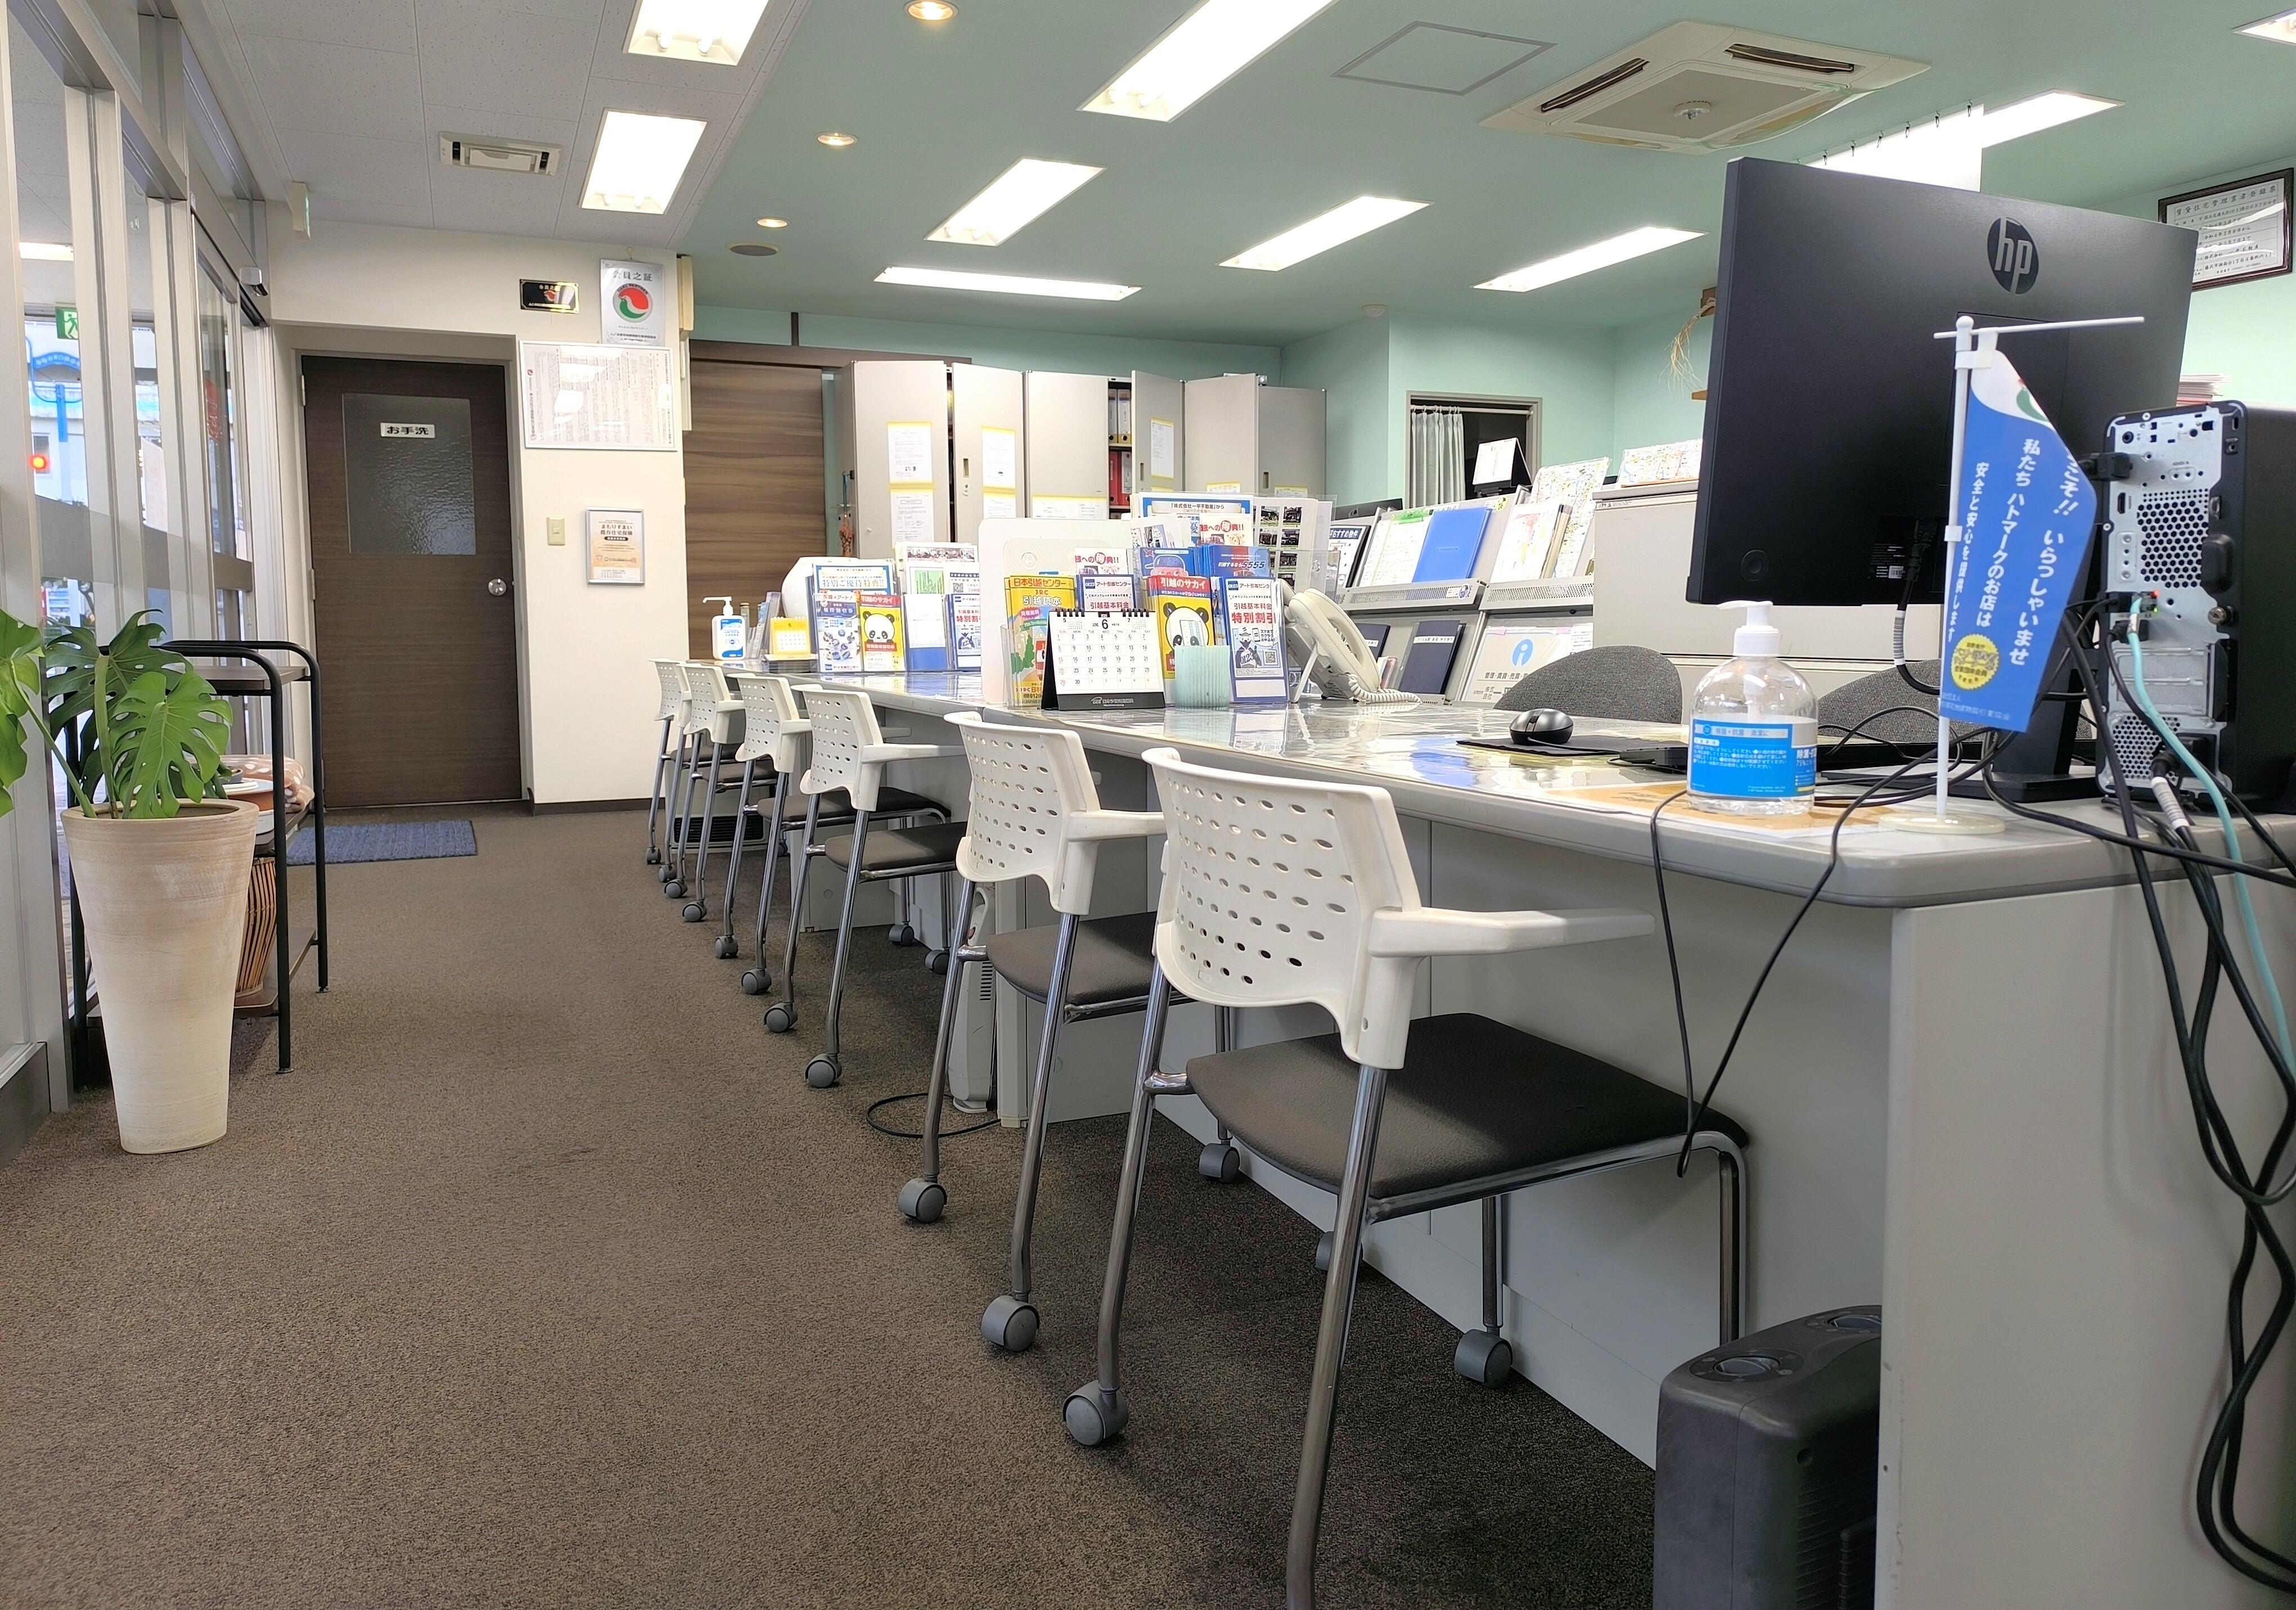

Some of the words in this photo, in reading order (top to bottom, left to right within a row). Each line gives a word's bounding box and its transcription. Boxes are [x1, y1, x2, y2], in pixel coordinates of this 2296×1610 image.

[1994, 217, 2033, 294] hp
[387, 426, 429, 435] お手洗
[2015, 438, 2041, 487] 私たち
[1976, 492, 2025, 628] ハトマークのお店は
[1014, 578, 1066, 587] 日本引越センター
[1160, 577, 1207, 590] 引越のサカイ
[2010, 530, 2064, 666] いらっしゃいませ
[1102, 619, 1108, 629] 6
[1231, 612, 1276, 624] 特別割引
